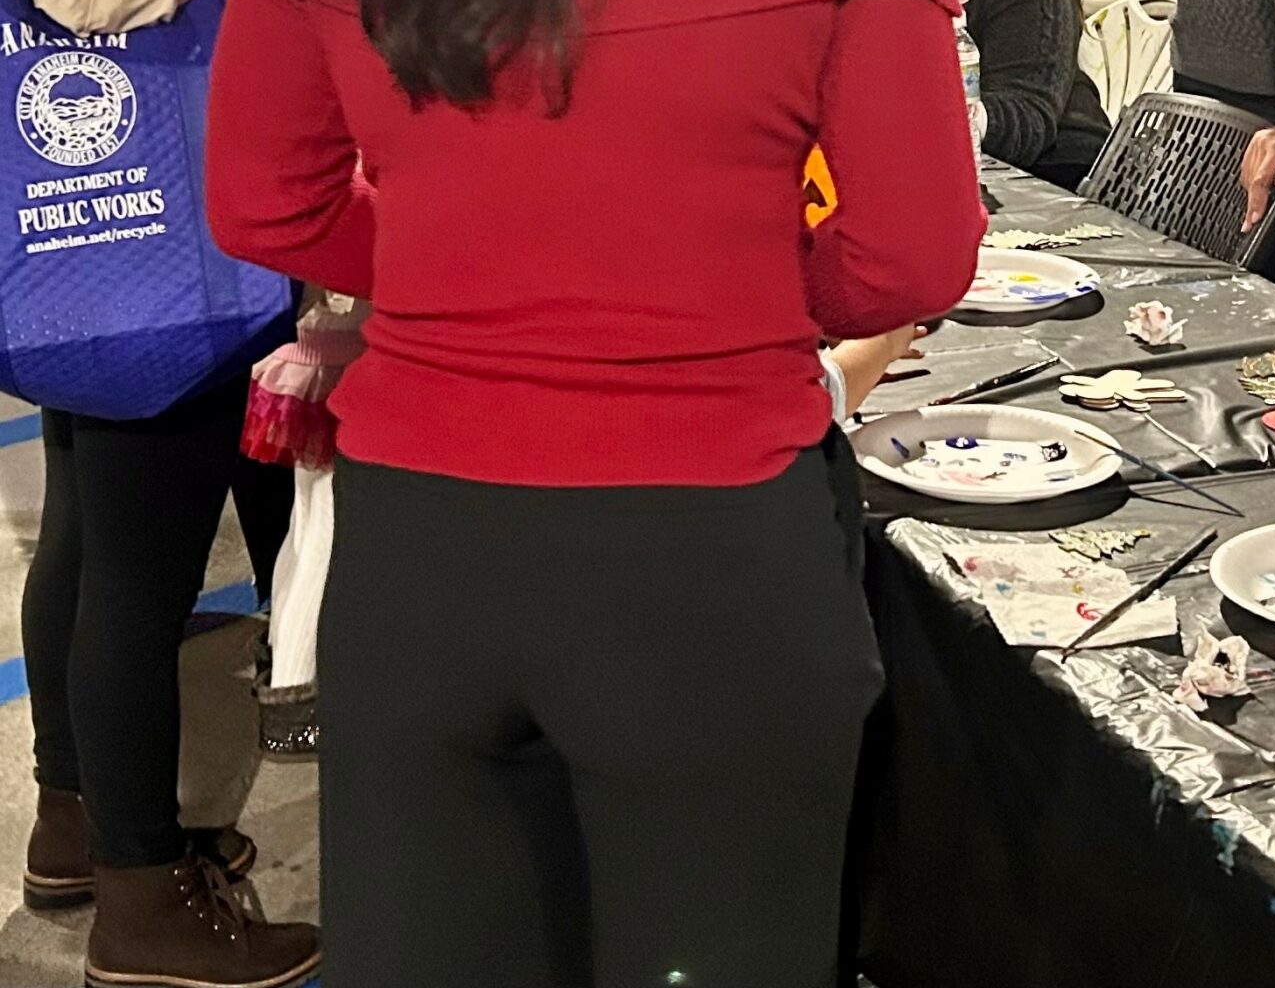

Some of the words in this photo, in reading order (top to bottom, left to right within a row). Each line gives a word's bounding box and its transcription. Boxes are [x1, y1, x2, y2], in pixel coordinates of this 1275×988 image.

[33, 53, 79, 82] ANAHEIM
[82, 53, 132, 100] CALIFORNIA
[41, 142, 96, 164] FOUNDED
[26, 169, 124, 199] DEPARTMENT
[126, 166, 148, 184] OF
[18, 199, 90, 234] PUBLIC
[91, 189, 165, 222] WORKS
[26, 222, 167, 254] anaheim.net/recycle
